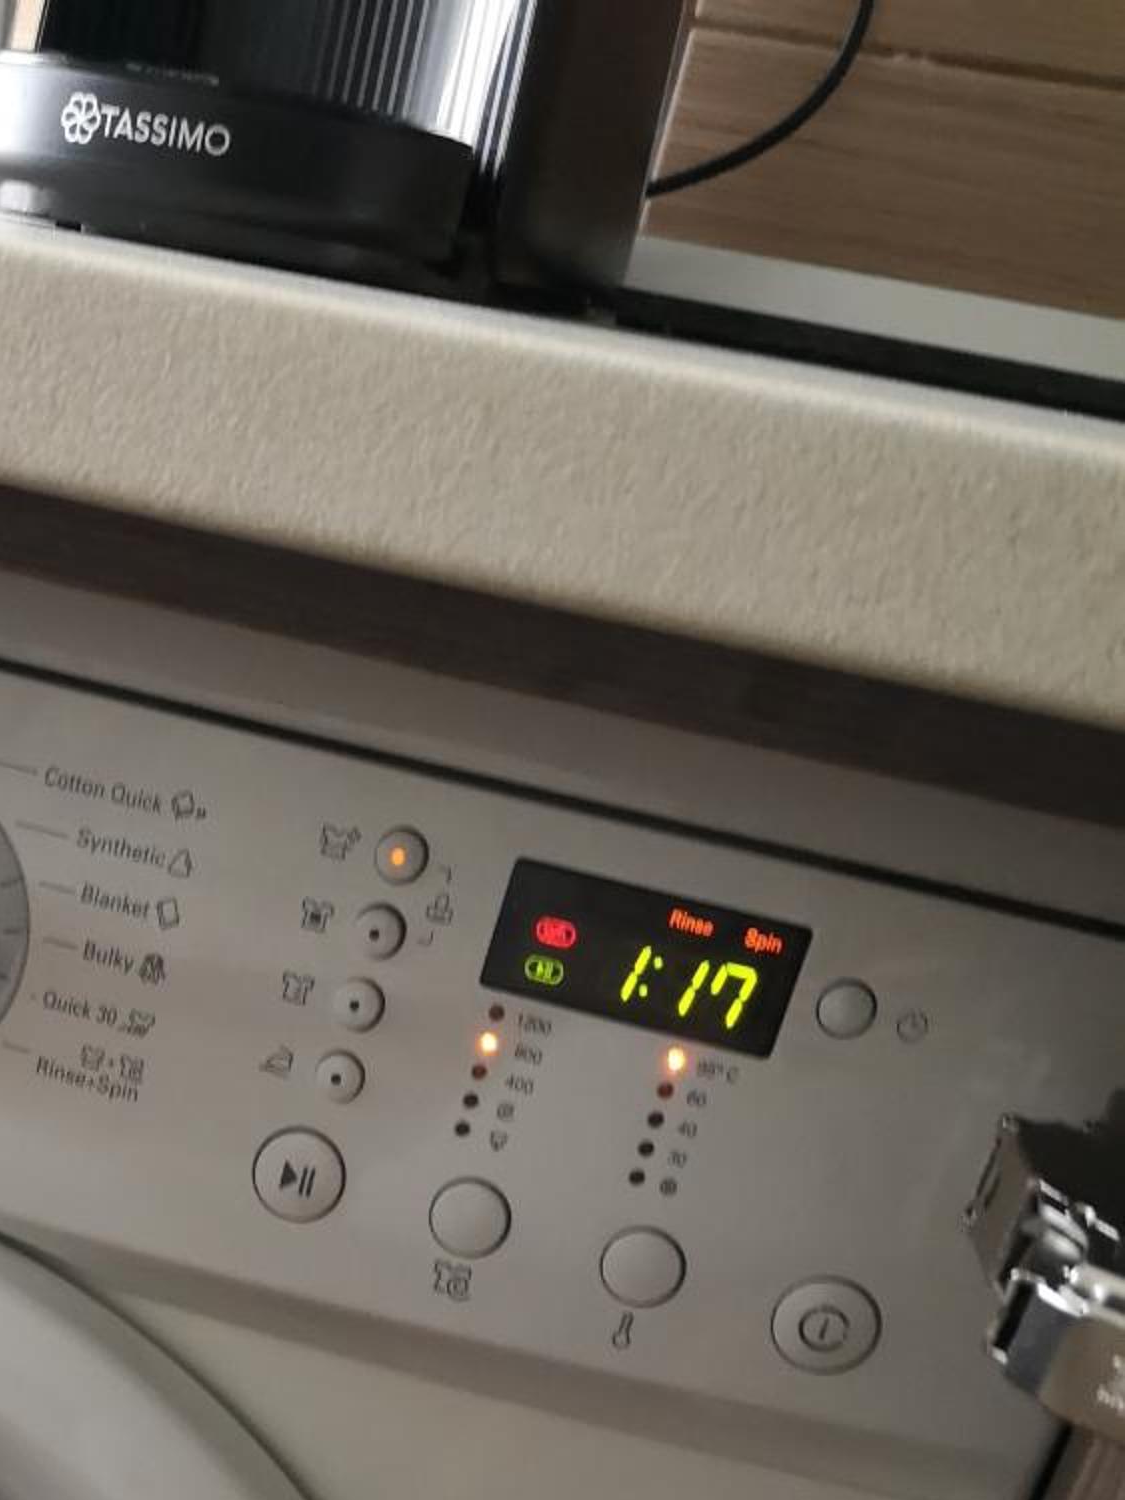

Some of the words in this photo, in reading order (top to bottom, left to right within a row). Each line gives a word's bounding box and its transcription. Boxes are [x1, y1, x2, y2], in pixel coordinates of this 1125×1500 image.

[100, 104, 231, 157] TASSIMO
[44, 766, 105, 801] Cotton
[111, 782, 163, 814] Quick
[76, 828, 166, 868] Synthetic
[80, 883, 149, 919] Blanket
[668, 908, 714, 939] Rinse
[744, 926, 783, 955] Spin
[83, 938, 134, 975] Bulky
[620, 945, 758, 1029] 1:17
[42, 991, 91, 1020] Quick
[95, 1003, 118, 1025] 30
